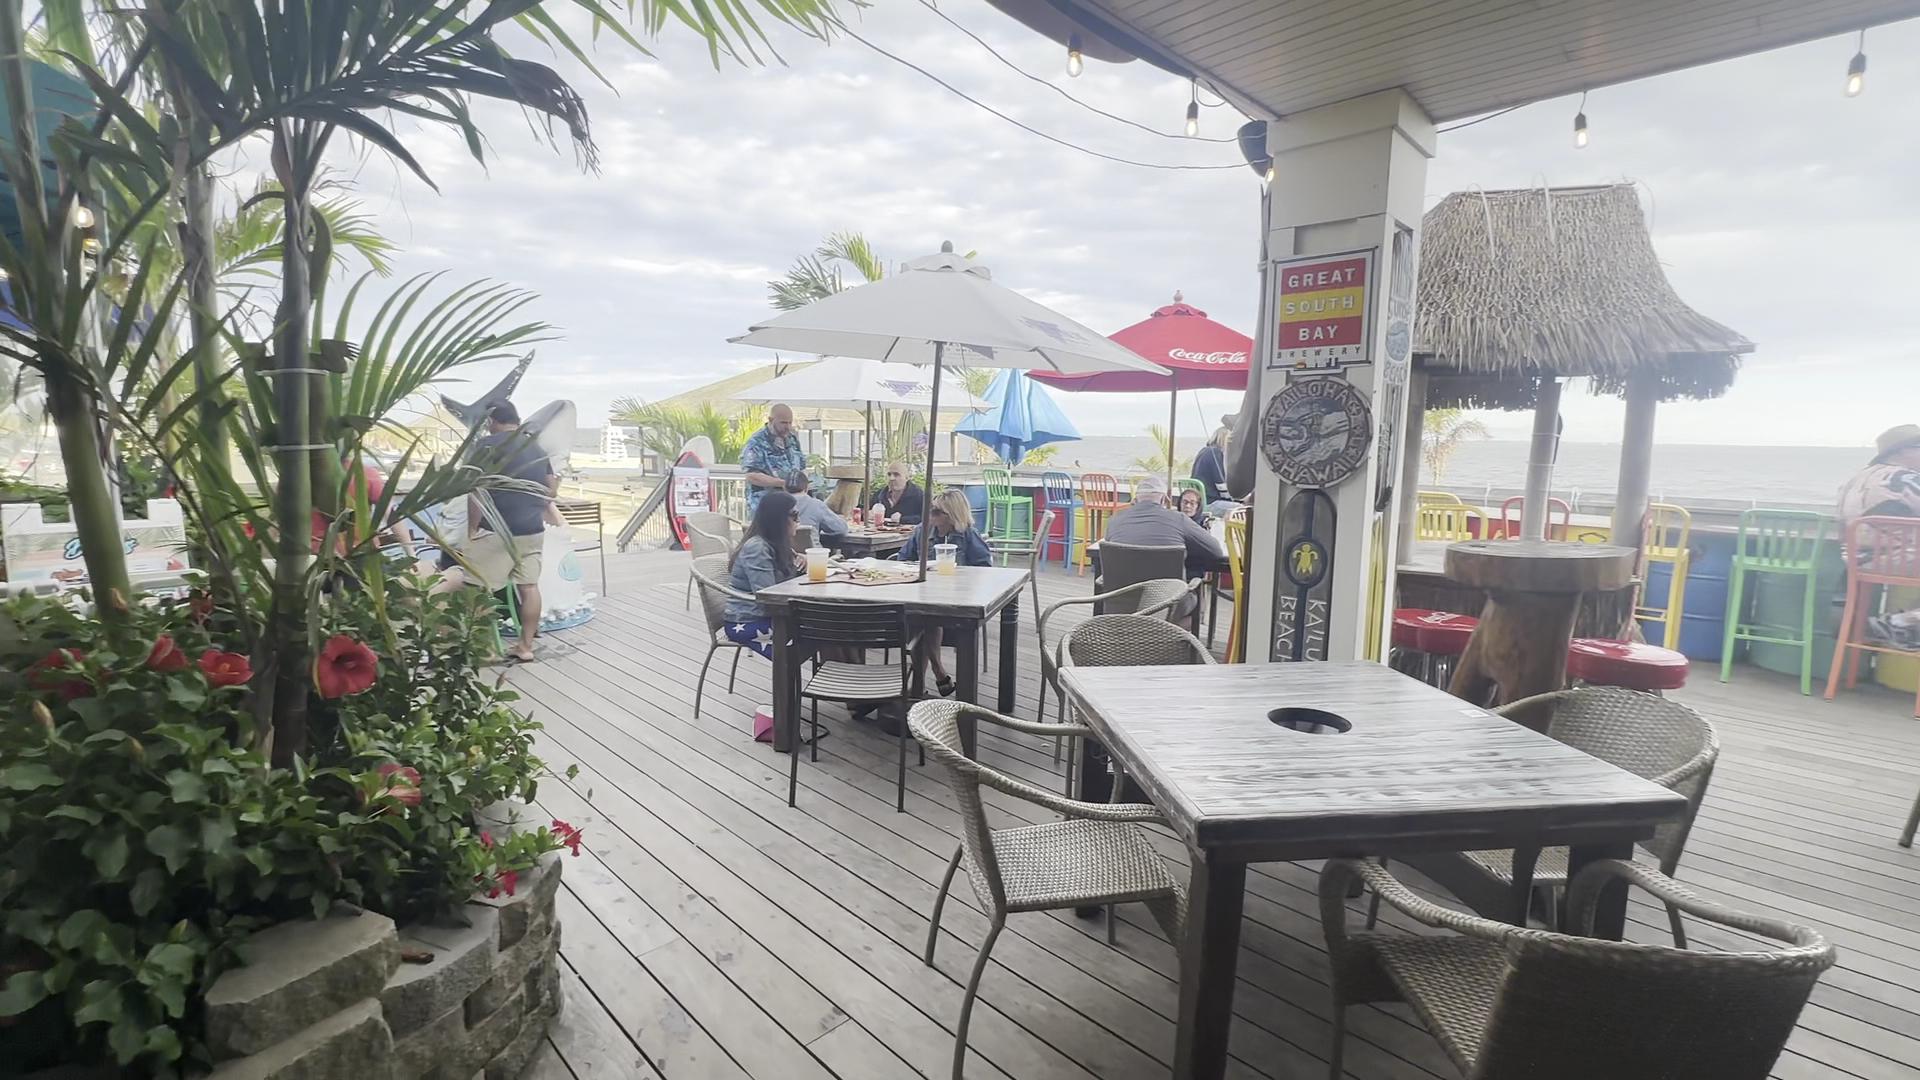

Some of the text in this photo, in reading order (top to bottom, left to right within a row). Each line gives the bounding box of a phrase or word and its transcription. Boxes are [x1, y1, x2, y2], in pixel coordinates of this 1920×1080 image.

[1288, 268, 1356, 288] GREAT
[1286, 295, 1355, 315] SOUTH
[1299, 325, 1338, 341] BAY
[1168, 348, 1248, 364] Coca-Cola
[1277, 346, 1361, 359] BREWERY
[1281, 382, 1348, 409] ALOHA
